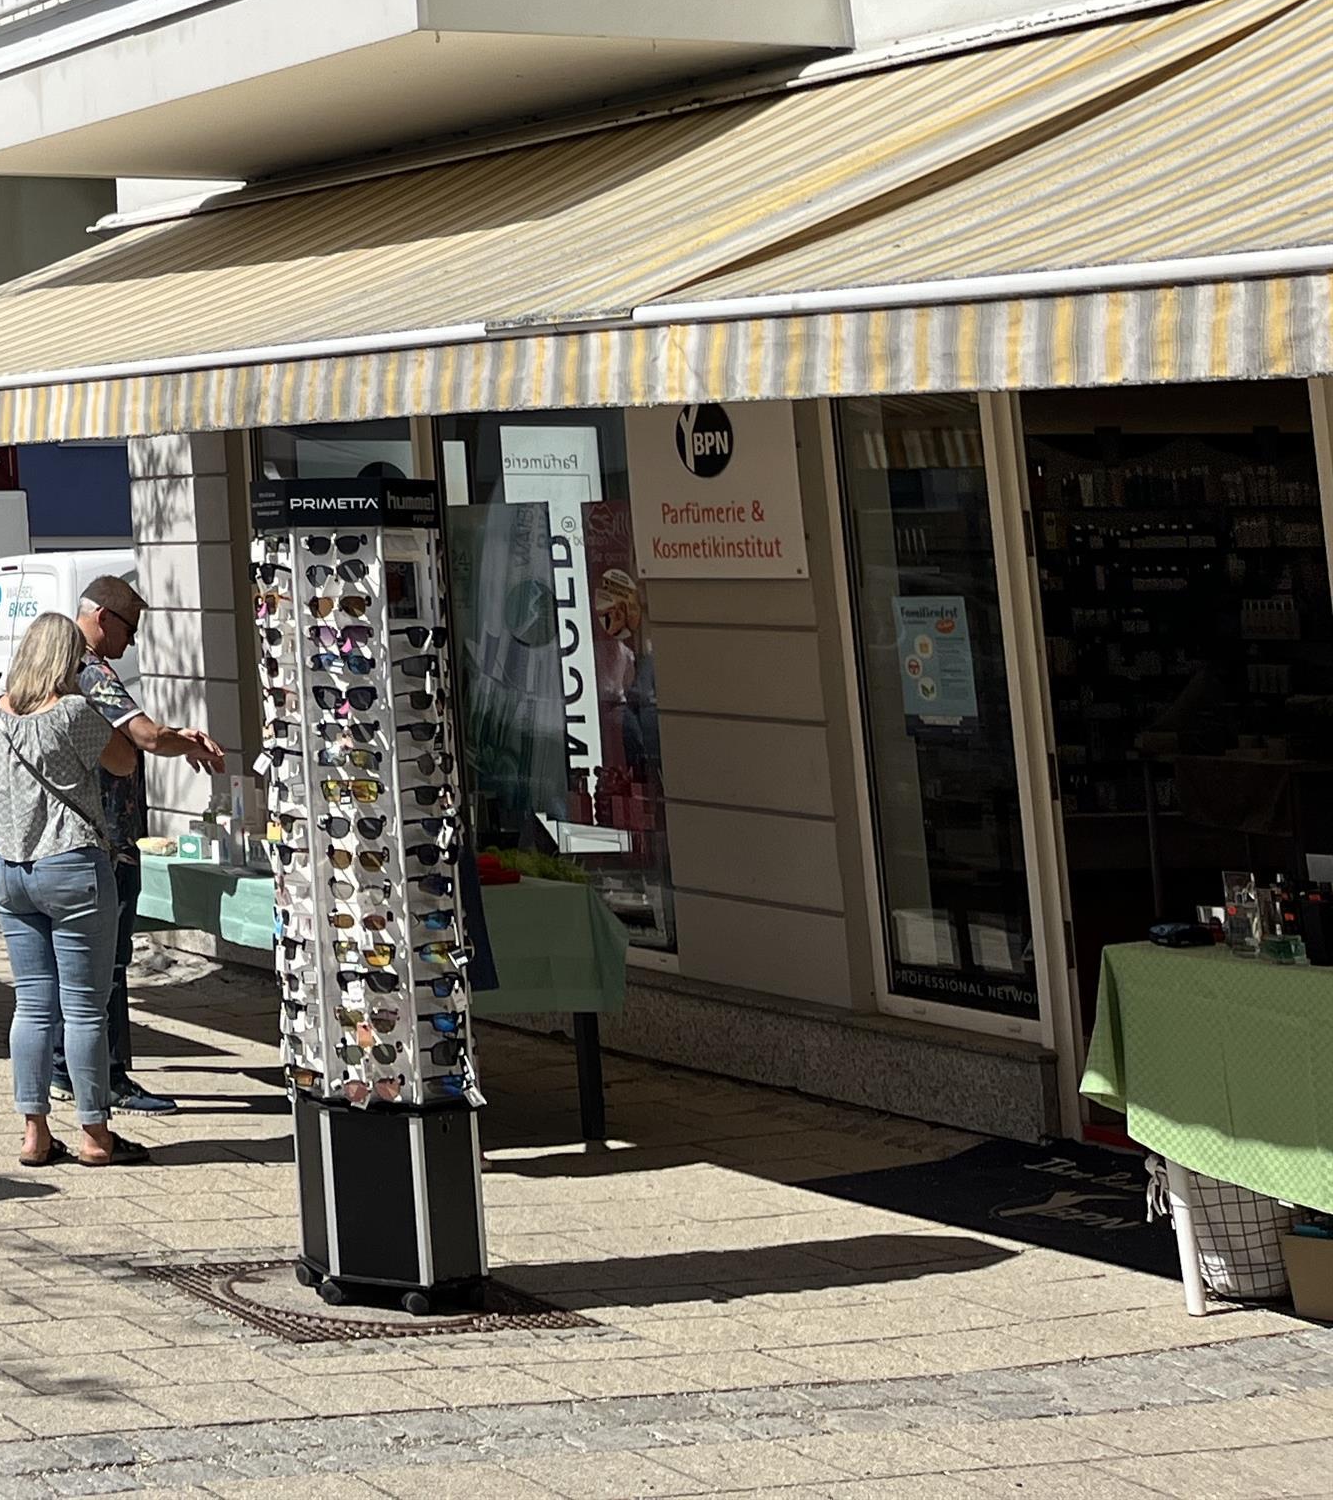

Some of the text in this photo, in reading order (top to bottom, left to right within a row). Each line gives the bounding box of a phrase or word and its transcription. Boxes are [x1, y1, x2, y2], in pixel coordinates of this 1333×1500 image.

[290, 497, 378, 510] PRIMETTA
[660, 500, 764, 525] Parfümerie &
[652, 535, 783, 560] Kosmetikinstitut
[8, 601, 39, 618] BIKES
[895, 970, 984, 997] PROFESSIONAL
